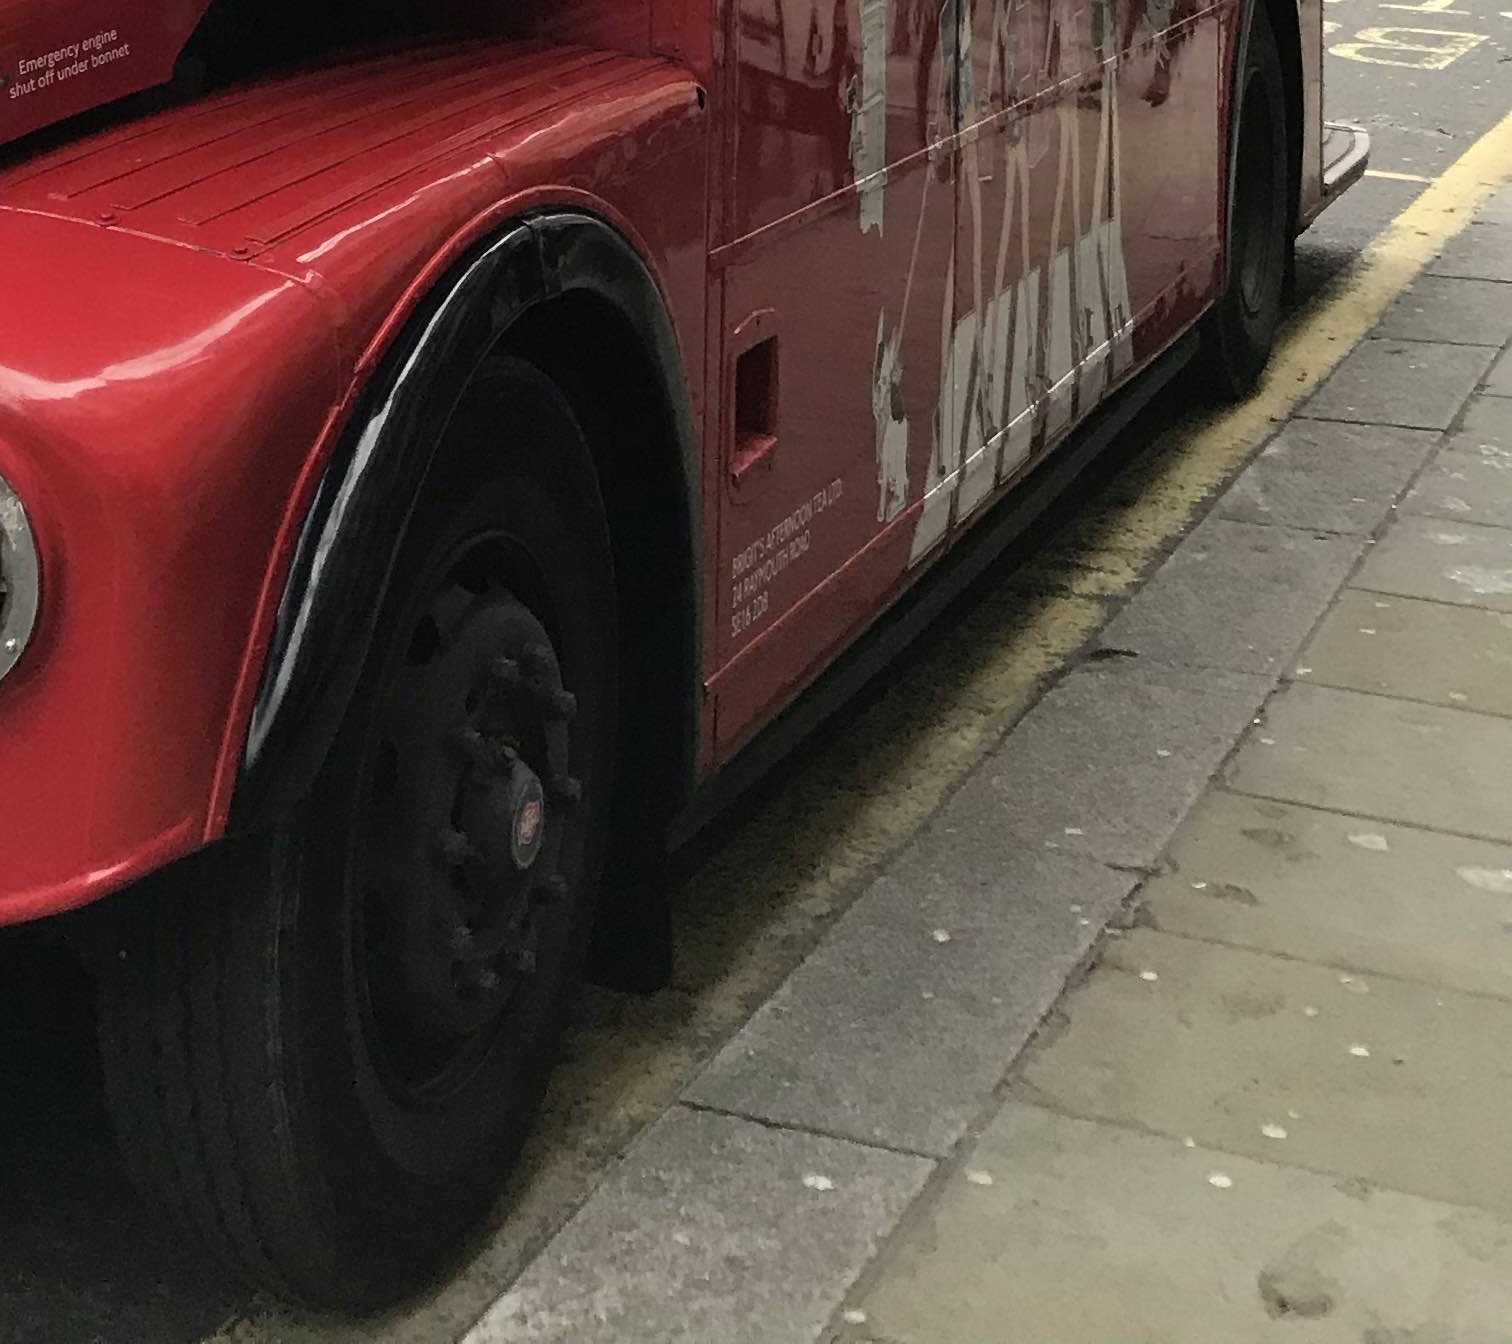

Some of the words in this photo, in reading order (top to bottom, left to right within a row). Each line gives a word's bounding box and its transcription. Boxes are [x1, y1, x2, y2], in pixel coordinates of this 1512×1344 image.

[8, 80, 37, 99] shut
[37, 70, 56, 90] off
[56, 60, 89, 83] under
[91, 43, 132, 70] bonnet
[18, 43, 80, 76] Emergency
[82, 27, 119, 53] engine
